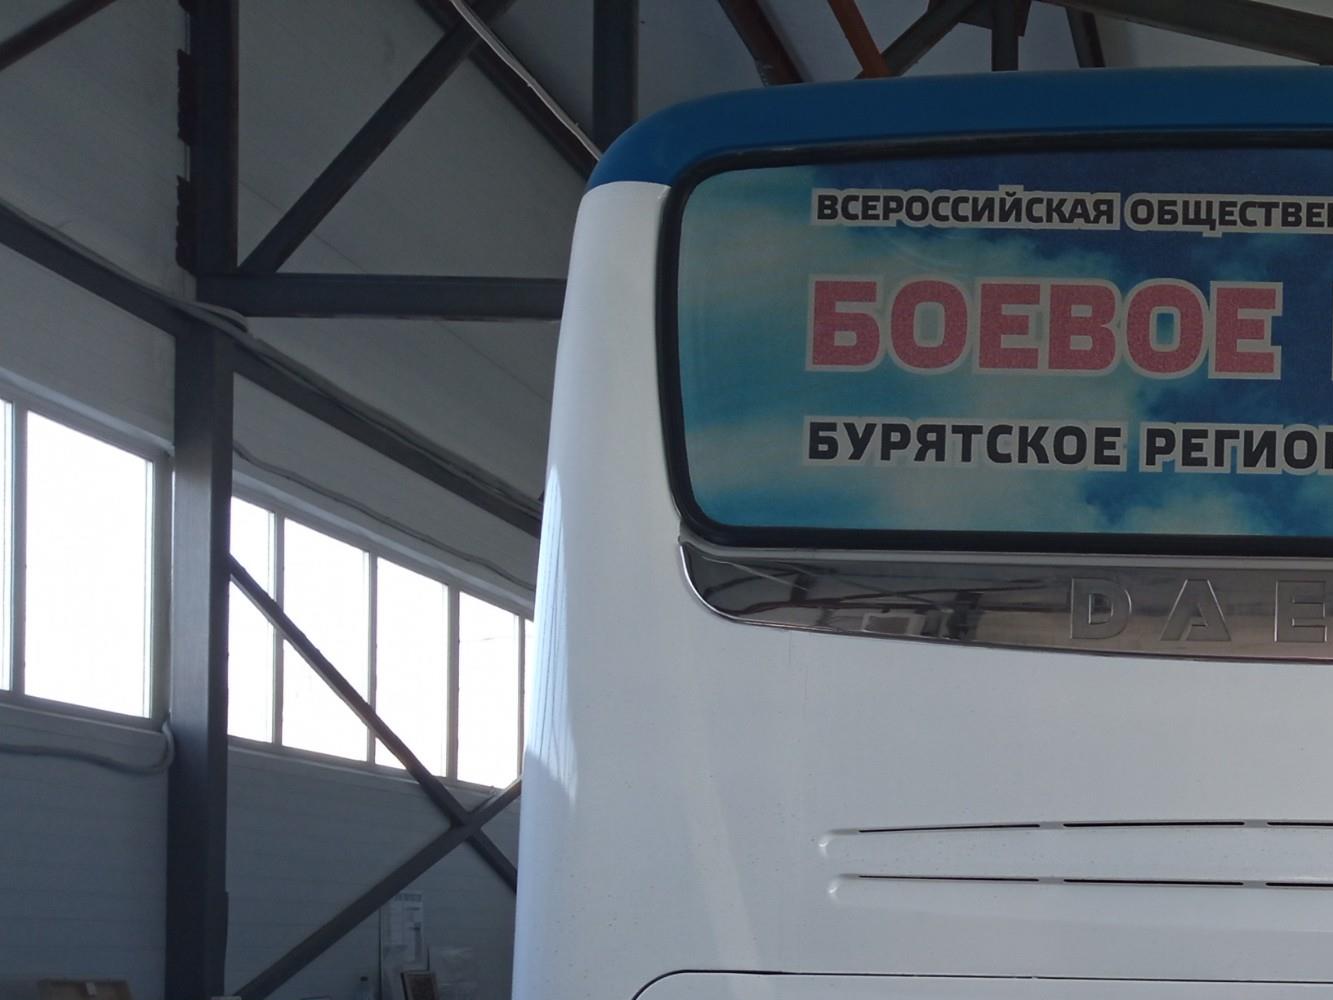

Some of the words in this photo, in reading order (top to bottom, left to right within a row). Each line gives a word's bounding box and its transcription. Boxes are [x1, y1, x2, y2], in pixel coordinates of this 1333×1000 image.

[816, 191, 1115, 225] ВСЕРОССИЙСКАЯ
[809, 277, 1280, 376] БОЕВОЕ
[807, 421, 1121, 466] БУРЯТСКОЕ
